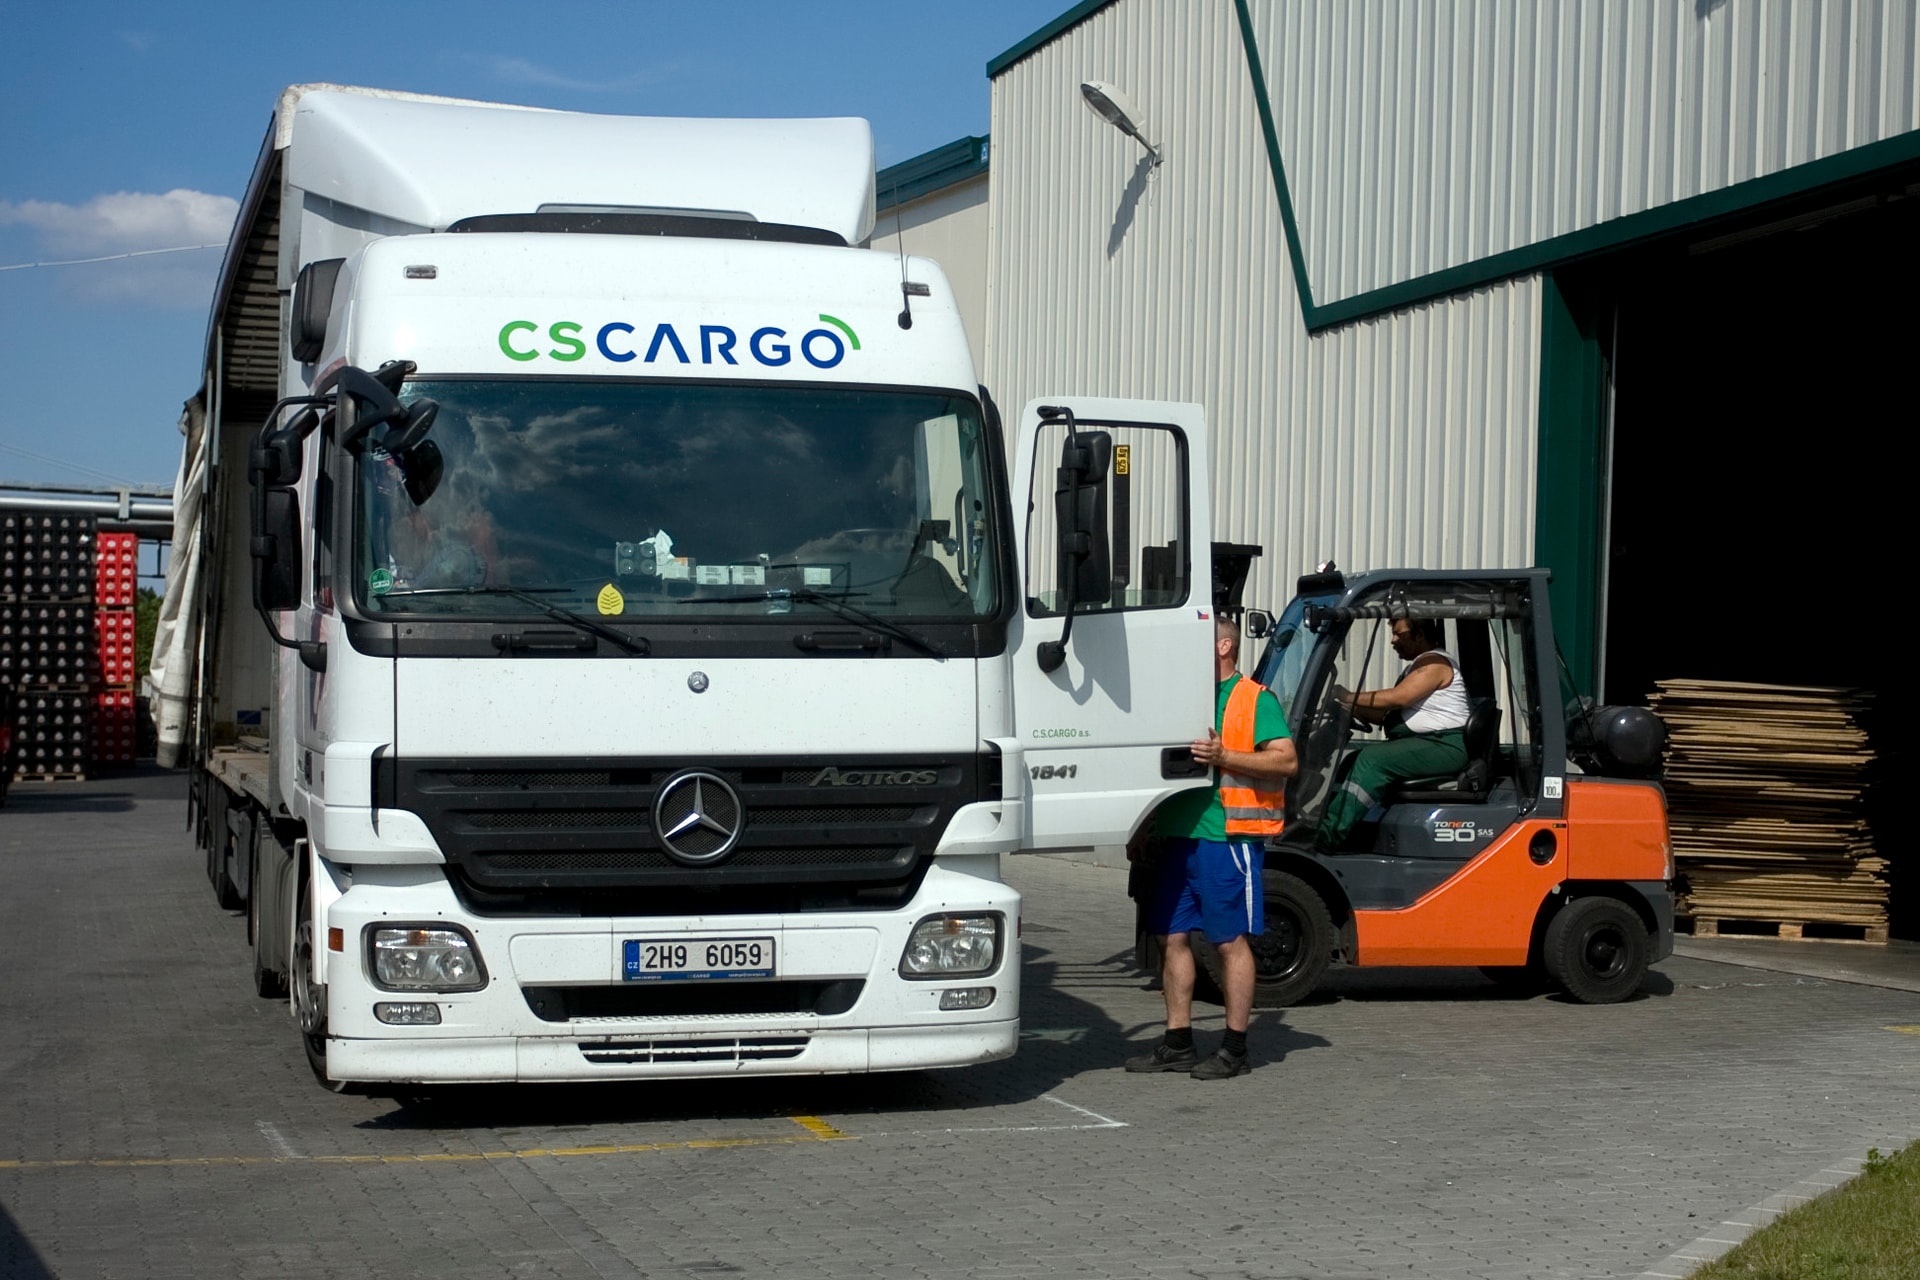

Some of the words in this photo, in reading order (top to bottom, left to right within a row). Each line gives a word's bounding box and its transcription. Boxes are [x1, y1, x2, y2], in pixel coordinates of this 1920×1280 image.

[1032, 728, 1077, 739] C.S.CARGO
[1030, 764, 1077, 780] 1841
[1434, 828, 1476, 842] 30
[1477, 828, 1494, 836] SAS
[645, 945, 687, 969] 2H9
[706, 943, 762, 967] 6059
[627, 961, 639, 969] CZ
